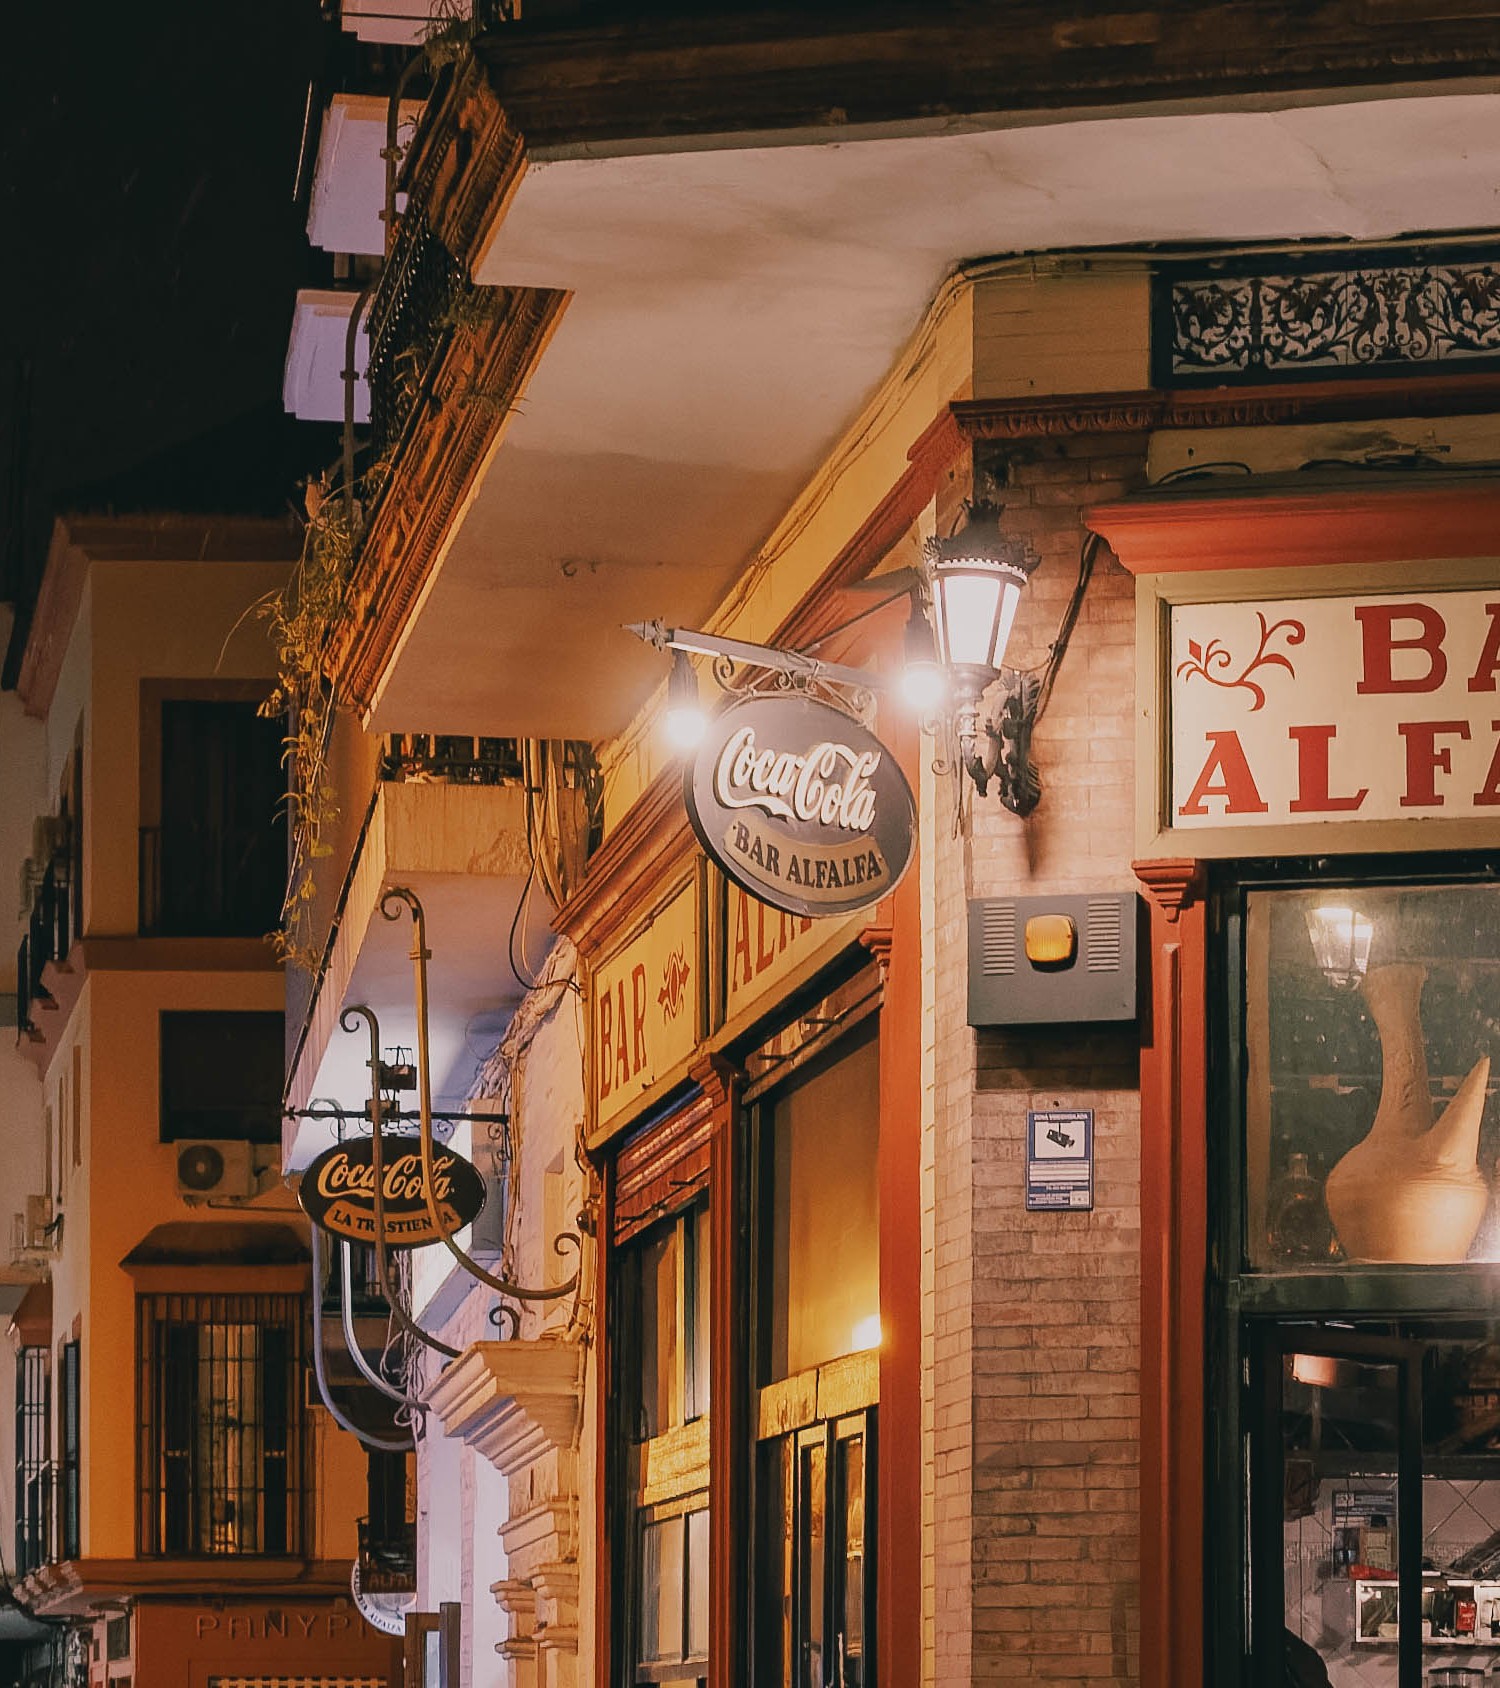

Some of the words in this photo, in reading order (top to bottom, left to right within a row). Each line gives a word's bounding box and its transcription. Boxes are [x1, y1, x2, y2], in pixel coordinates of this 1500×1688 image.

[734, 820, 780, 877] BAR
[786, 849, 883, 889] ALFALFA
[600, 962, 647, 1101] BAR
[332, 1209, 352, 1227] LA
[355, 1210, 455, 1234] TRSTIENA
